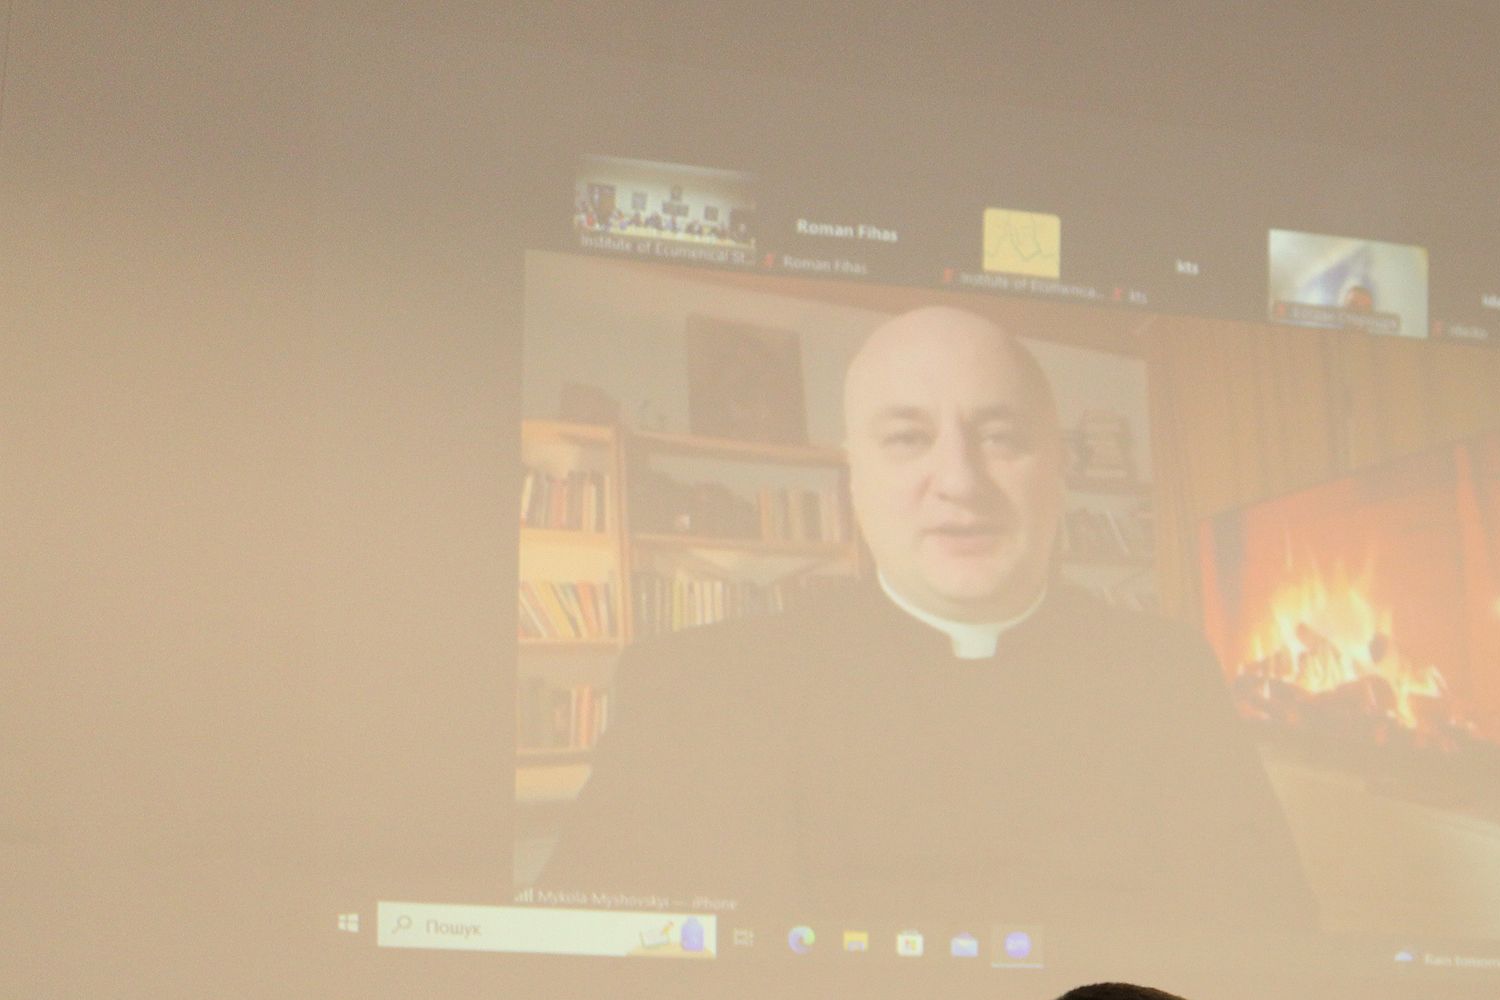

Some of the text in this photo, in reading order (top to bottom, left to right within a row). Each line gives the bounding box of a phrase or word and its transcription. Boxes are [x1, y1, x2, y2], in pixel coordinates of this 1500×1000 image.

[796, 219, 899, 243] Roman Fihas
[636, 239, 652, 255] of
[782, 254, 868, 276] Roman Fihas
[425, 918, 481, 940] Пошук
